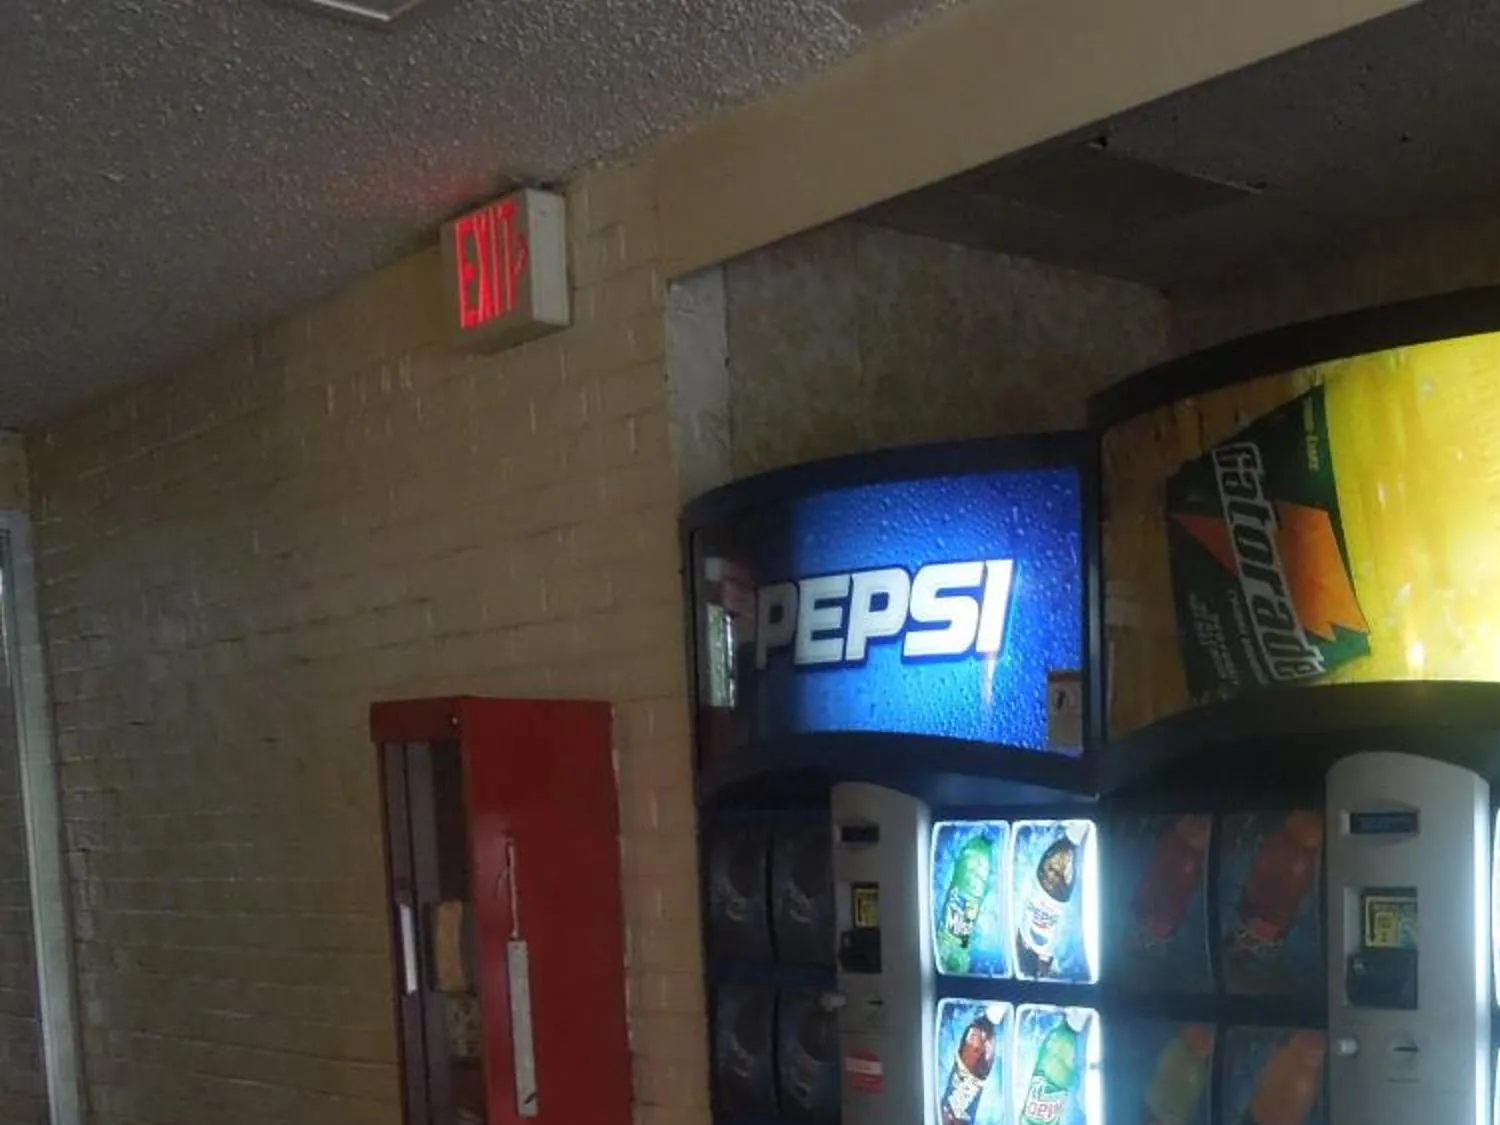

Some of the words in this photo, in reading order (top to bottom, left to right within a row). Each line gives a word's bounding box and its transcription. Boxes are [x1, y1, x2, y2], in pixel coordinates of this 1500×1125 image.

[455, 197, 518, 329] EXIT
[754, 557, 1017, 671] PEPSI
[1212, 441, 1326, 681] Gatorade
